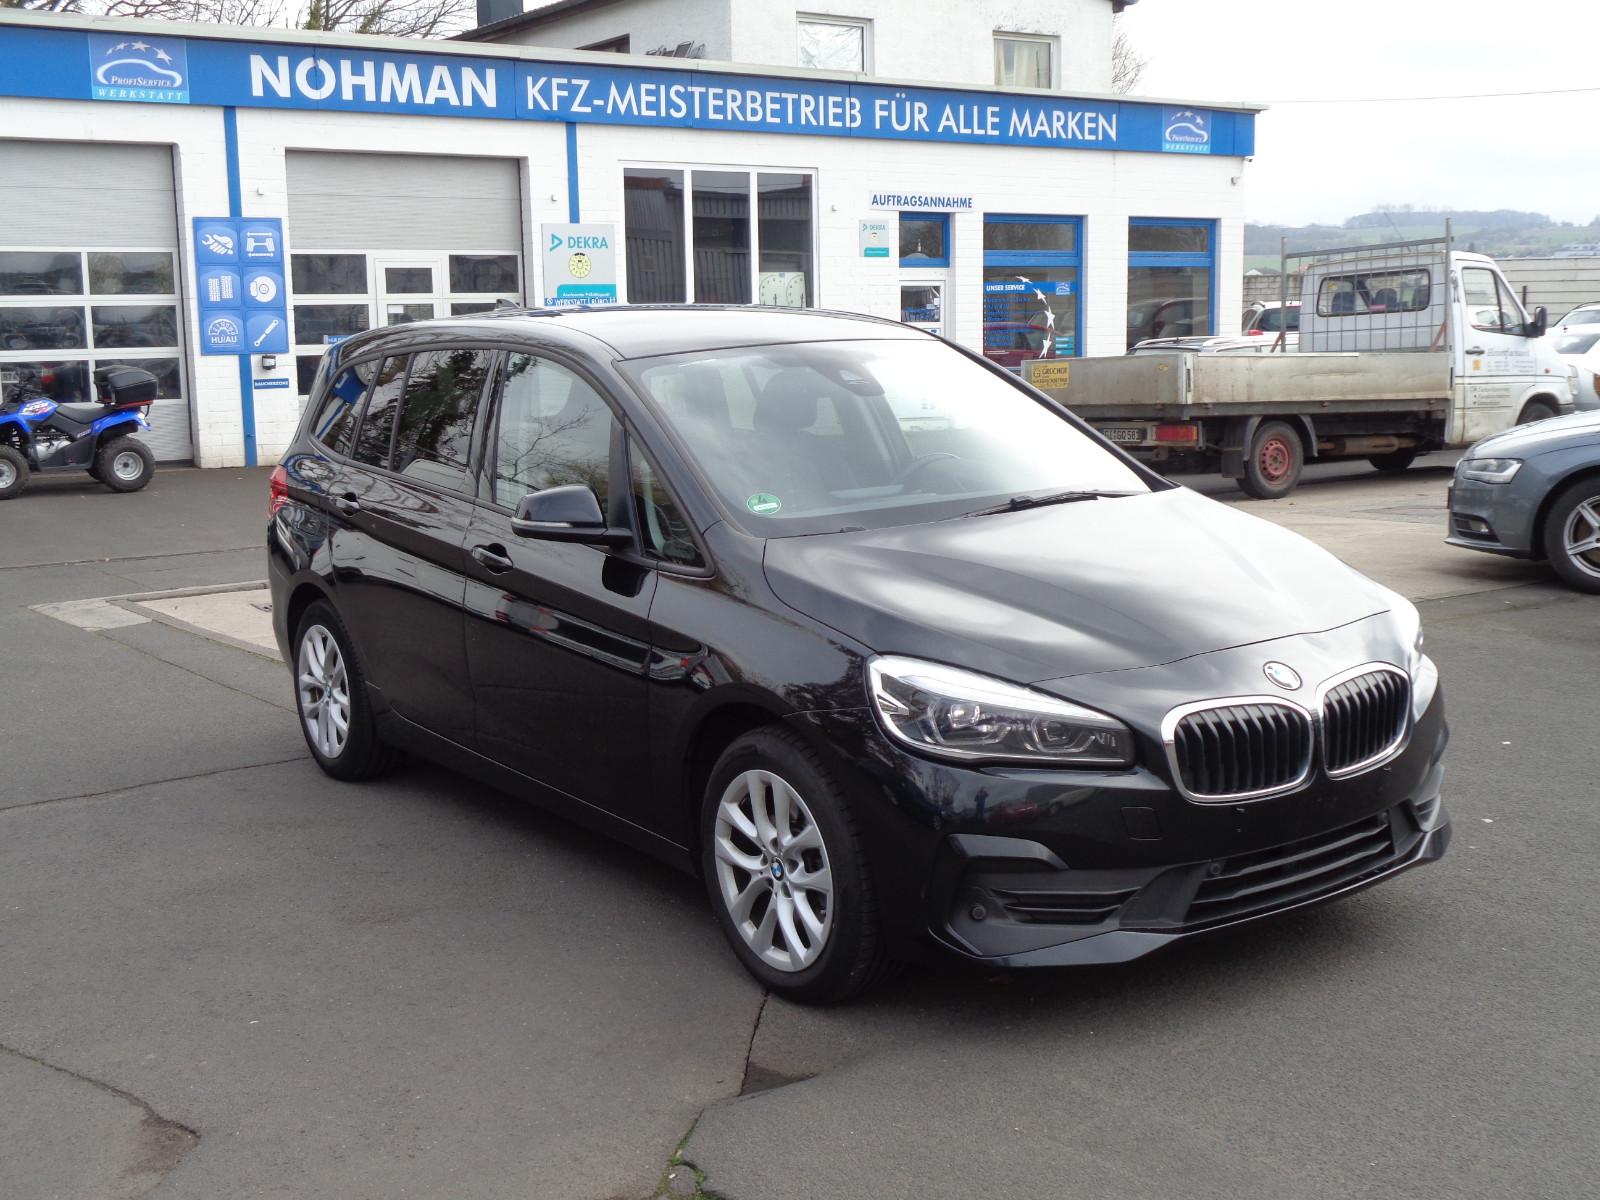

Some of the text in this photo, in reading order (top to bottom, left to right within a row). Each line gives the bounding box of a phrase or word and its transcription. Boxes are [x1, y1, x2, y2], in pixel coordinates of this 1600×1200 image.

[250, 54, 497, 108] NOHMAN
[98, 88, 184, 101] WERKSTATT
[526, 75, 1117, 142] KFZ-MEISTERBETRIEB FÜR ALLE MARKEN
[871, 194, 973, 209] AUFTRAGSANNAHME
[567, 236, 609, 249] DEKRA
[211, 335, 237, 344] HU/AU
